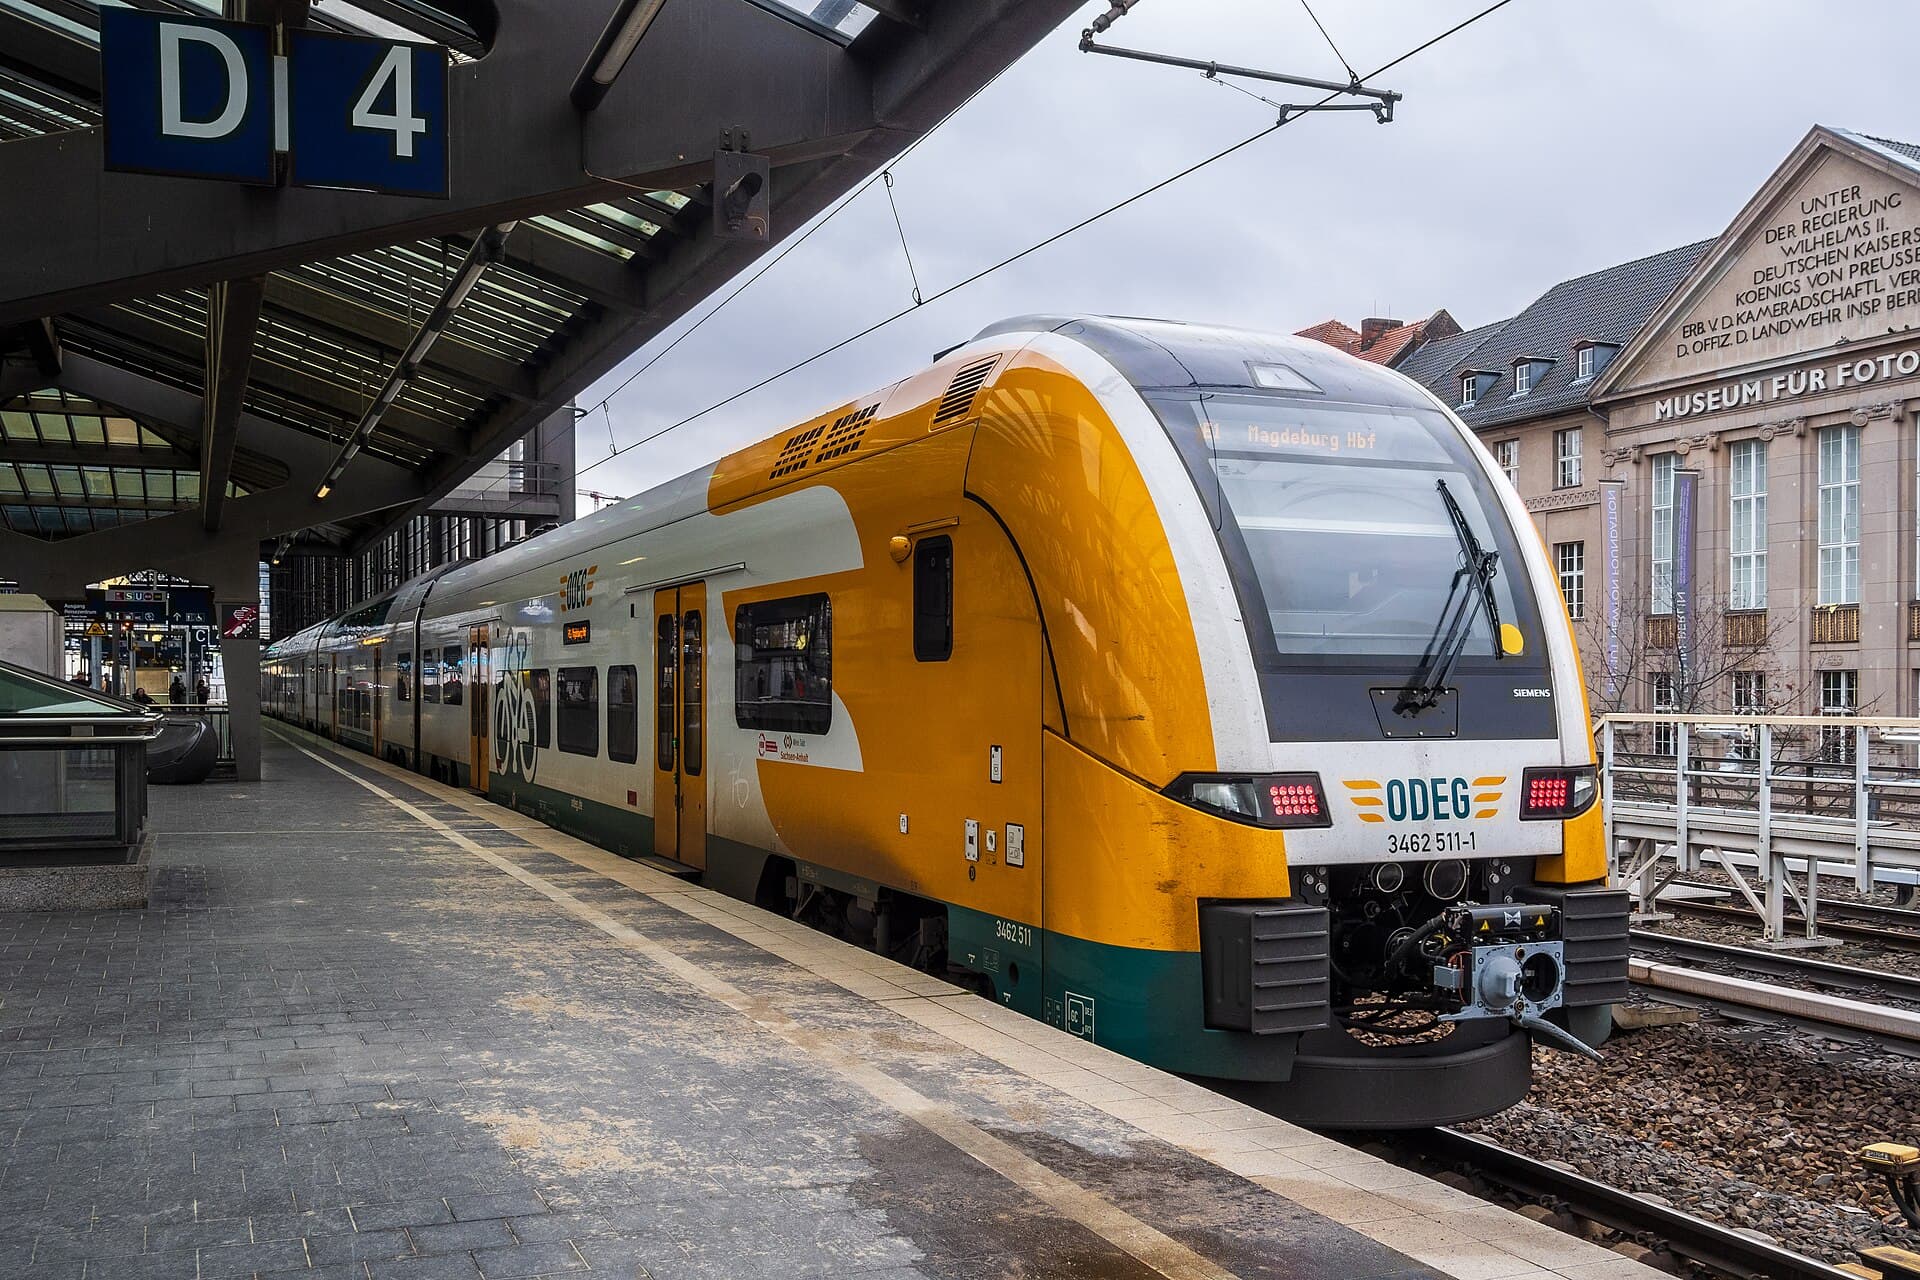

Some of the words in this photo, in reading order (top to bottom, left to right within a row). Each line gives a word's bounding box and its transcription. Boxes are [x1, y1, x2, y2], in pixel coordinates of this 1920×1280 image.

[159, 21, 249, 139] D
[352, 46, 426, 157] 4
[1765, 224, 1797, 244] DER
[1802, 192, 1902, 234] REGIERUNG
[1801, 185, 1861, 214] UNTER
[1753, 246, 1849, 285] DEUTSCHEN
[1854, 227, 1920, 259] KAISERS
[1780, 221, 1871, 257] WILHELMS
[1735, 279, 1801, 307] KOENIGS
[1807, 267, 1843, 289] VON
[1692, 333, 1733, 354] OFFIZ.
[1752, 307, 1842, 341] LANDWEHR
[1655, 380, 1763, 420] MUSEUM
[1772, 369, 1828, 399] FÜR
[1836, 350, 1920, 386] FOTO
[1248, 425, 1339, 451] Magdeburg
[1347, 432, 1377, 449] Hbf
[566, 568, 587, 610] ODEG
[195, 629, 206, 642] C
[1513, 688, 1551, 698] SIEMENS
[1386, 777, 1471, 822] ODEG
[1387, 833, 1431, 854] 3462
[1435, 831, 1476, 851] 511-1
[995, 919, 1017, 943] 3462
[1018, 926, 1032, 947] 511
